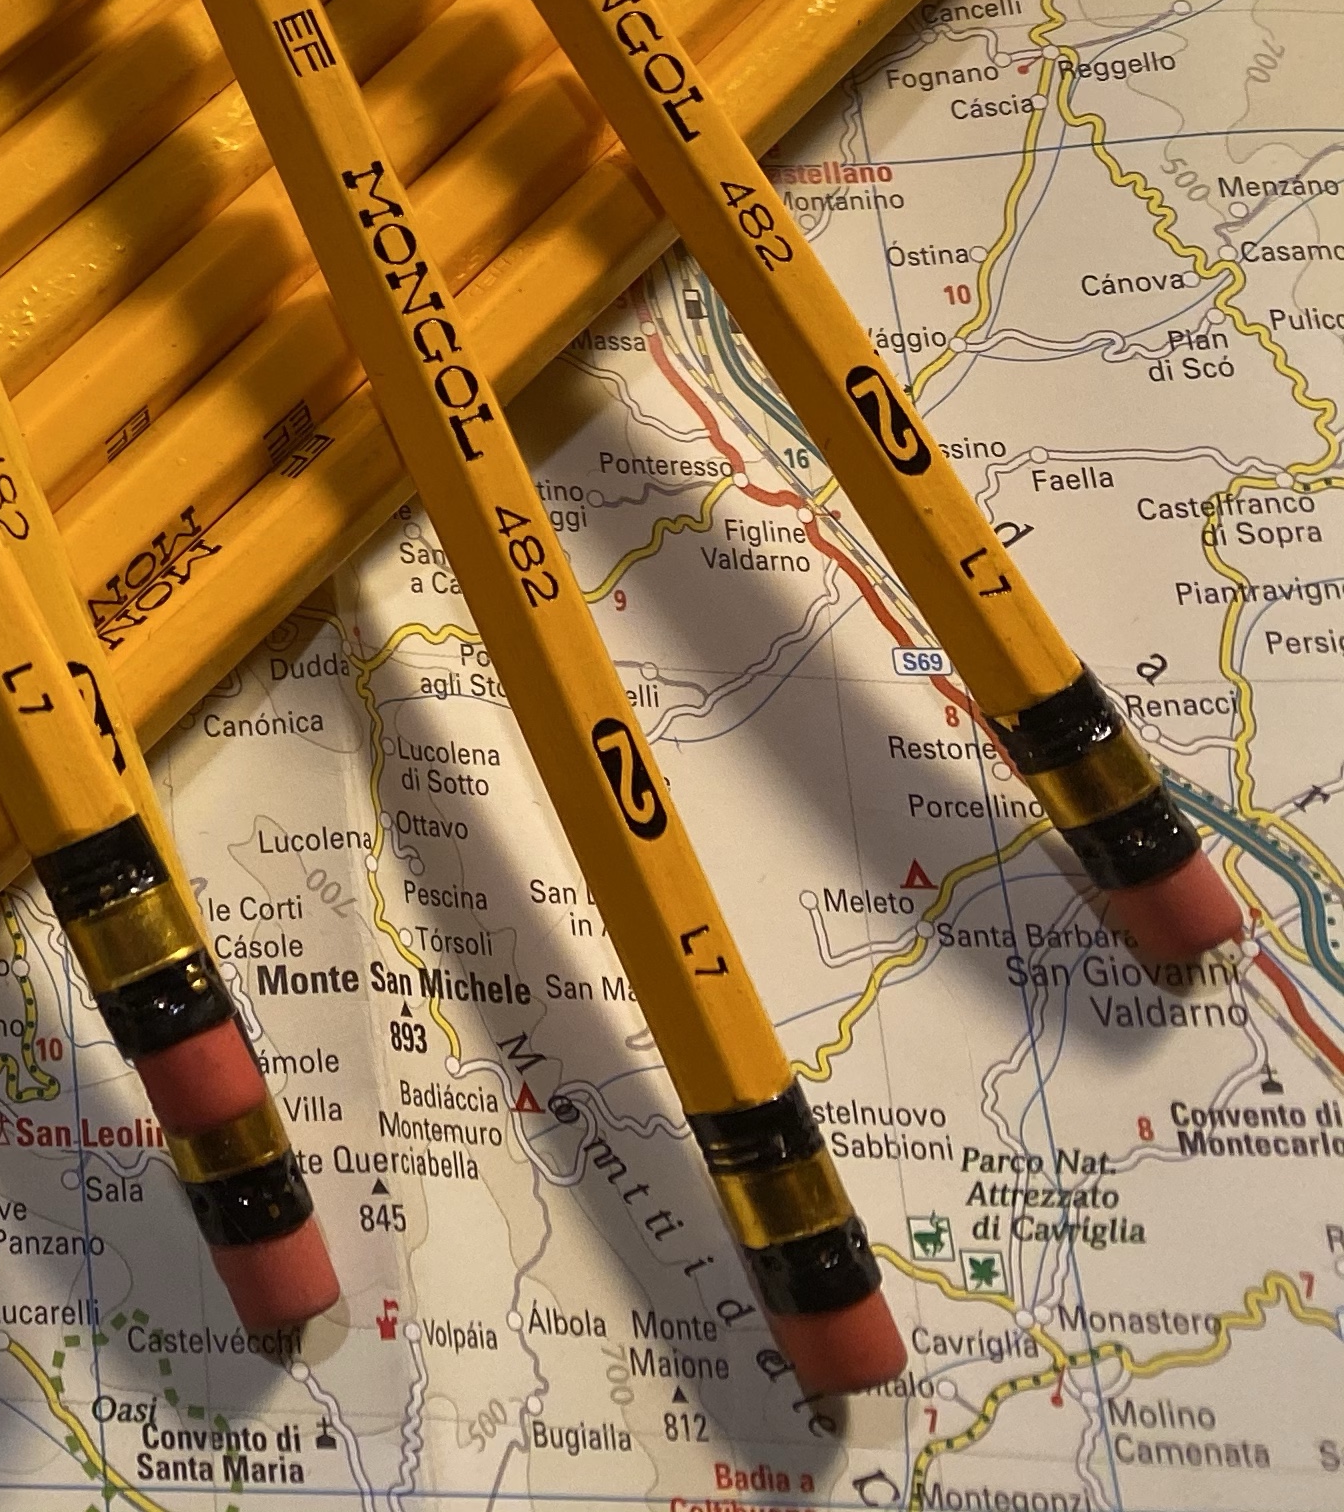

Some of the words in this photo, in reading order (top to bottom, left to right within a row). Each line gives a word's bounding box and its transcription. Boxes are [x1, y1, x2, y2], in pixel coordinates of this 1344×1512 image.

[1058, 52, 1175, 82] Reggello
[887, 239, 969, 267] Óstina
[720, 177, 794, 270] 482
[960, 547, 1012, 597] L7
[600, 453, 733, 477] Ponteresso
[273, 9, 336, 77] EF
[342, 161, 494, 461] MONGOL
[494, 506, 559, 608] 482
[681, 924, 730, 977] L7
[1032, 467, 1114, 493] Faella
[902, 651, 943, 672] S69
[3, 663, 54, 716] L7
[1125, 693, 1238, 718] Renacci
[258, 827, 373, 854] Lucolena
[824, 890, 915, 914] Meleto
[257, 965, 359, 995] Monte
[371, 965, 412, 996] San
[418, 968, 531, 1006] Michele
[390, 1021, 428, 1053] 893
[961, 1148, 1044, 1174] Parco
[1055, 1148, 1116, 1174] Nat.
[965, 1181, 1119, 1209] Attrezzato
[360, 1206, 406, 1233] 845
[973, 1215, 1002, 1242] di
[143, 1424, 270, 1453] Convento
[278, 1426, 301, 1453] di
[137, 1454, 215, 1482] Santa
[223, 1456, 304, 1483] Maria
